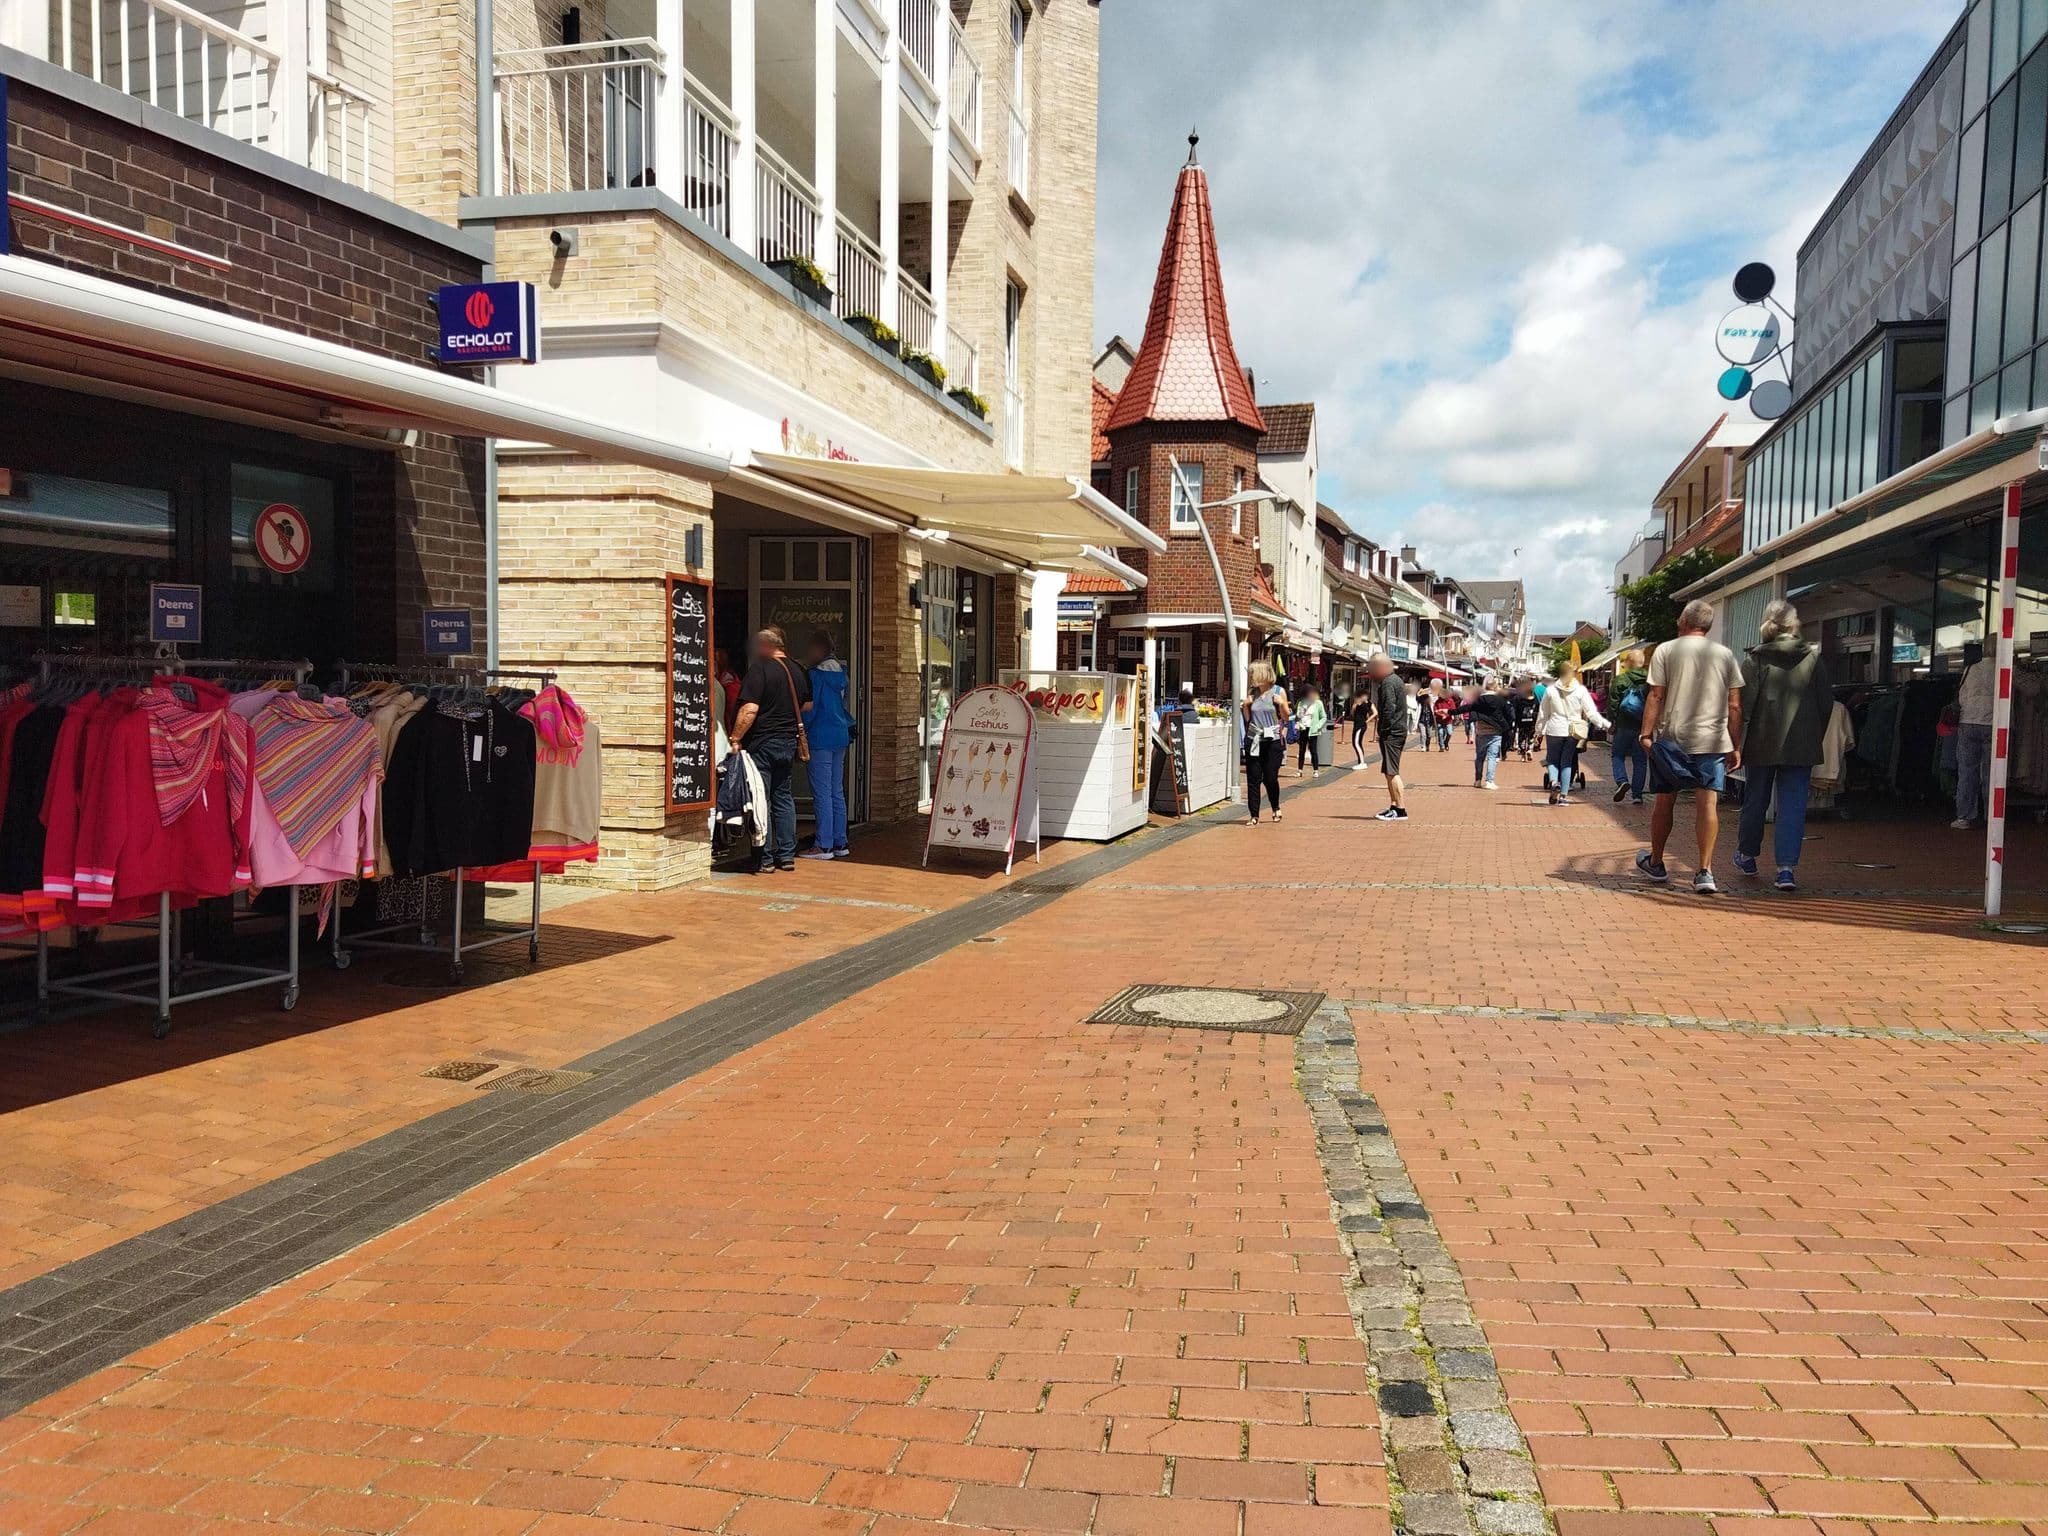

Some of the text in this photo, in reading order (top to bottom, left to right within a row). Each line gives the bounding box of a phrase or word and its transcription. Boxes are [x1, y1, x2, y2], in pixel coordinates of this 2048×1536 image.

[447, 332, 513, 348] ECHOLOT
[159, 598, 194, 610] Deerns
[806, 596, 831, 606] Fruit
[431, 619, 465, 628] Deerns
[969, 717, 1009, 730] Ieshuus
